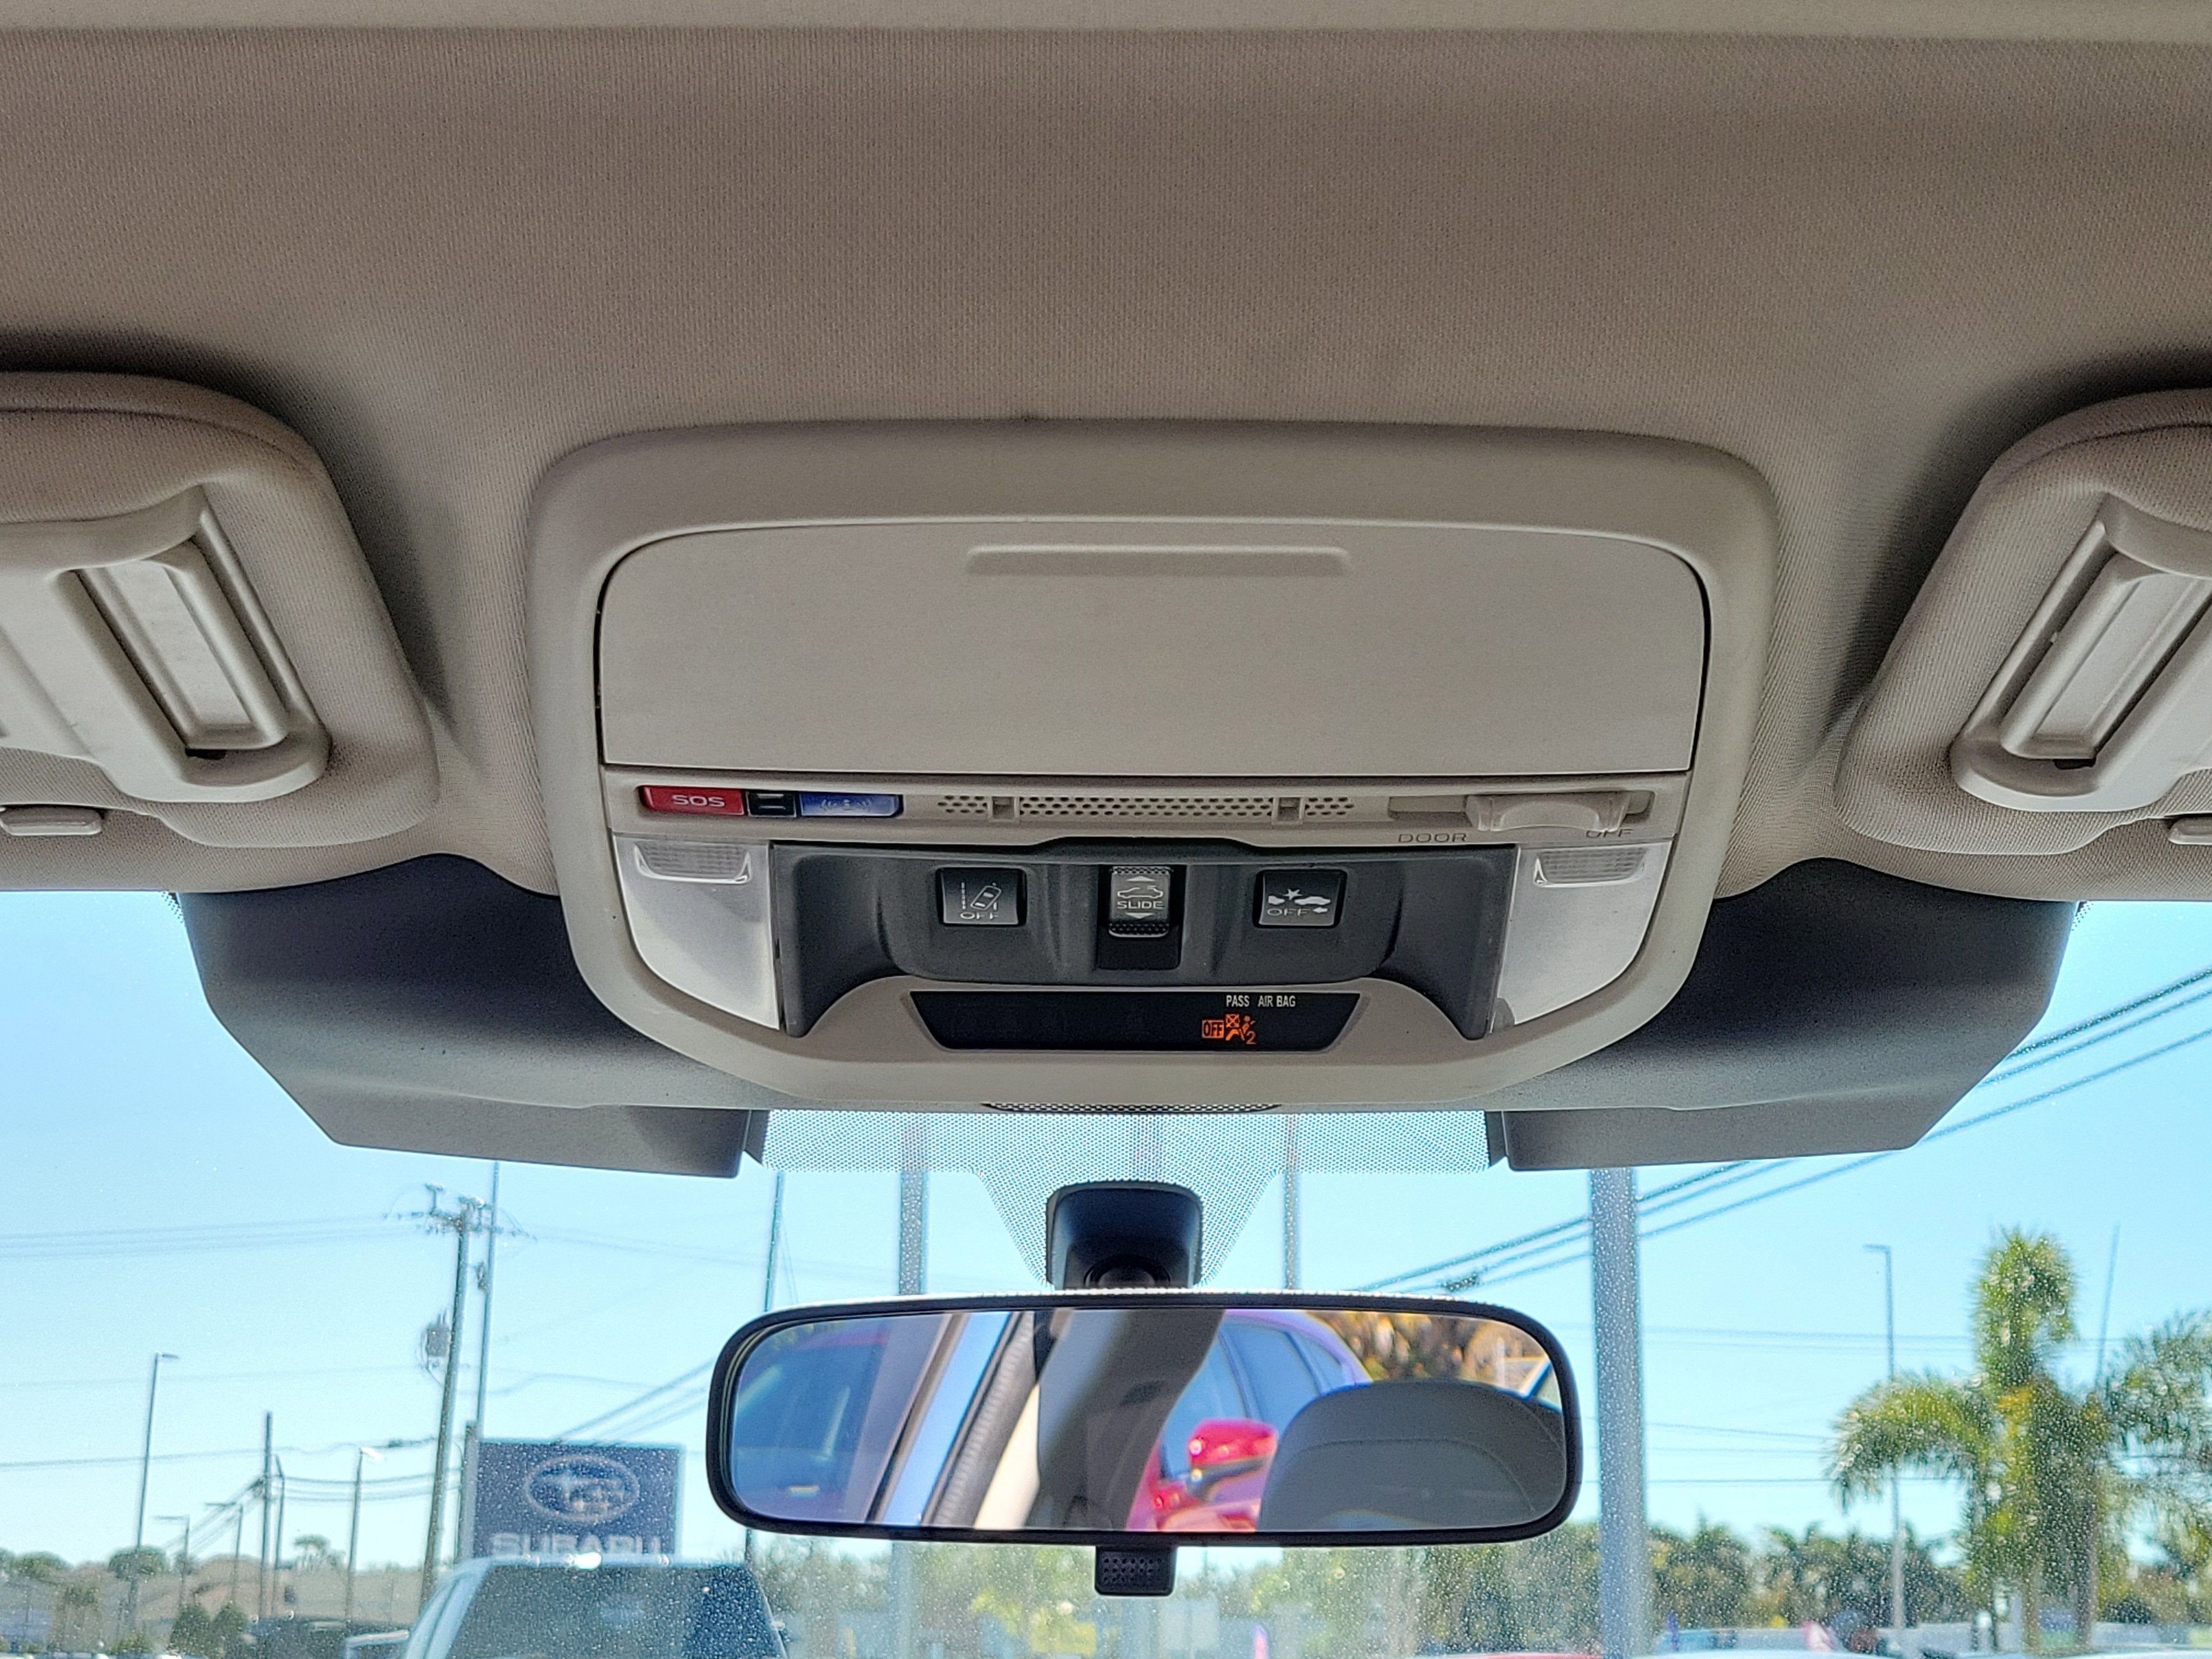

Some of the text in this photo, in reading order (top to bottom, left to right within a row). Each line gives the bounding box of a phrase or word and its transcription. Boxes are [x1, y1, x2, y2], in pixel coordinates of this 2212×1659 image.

[672, 794, 725, 807] SOS
[1398, 833, 1467, 843] DOOR
[1117, 900, 1164, 910] SLIDE
[1267, 908, 1310, 916] OFF
[1226, 995, 1296, 1007] PASS AIR BAG
[1203, 1021, 1224, 1037] OFF
[1246, 1030, 1256, 1045] 2
